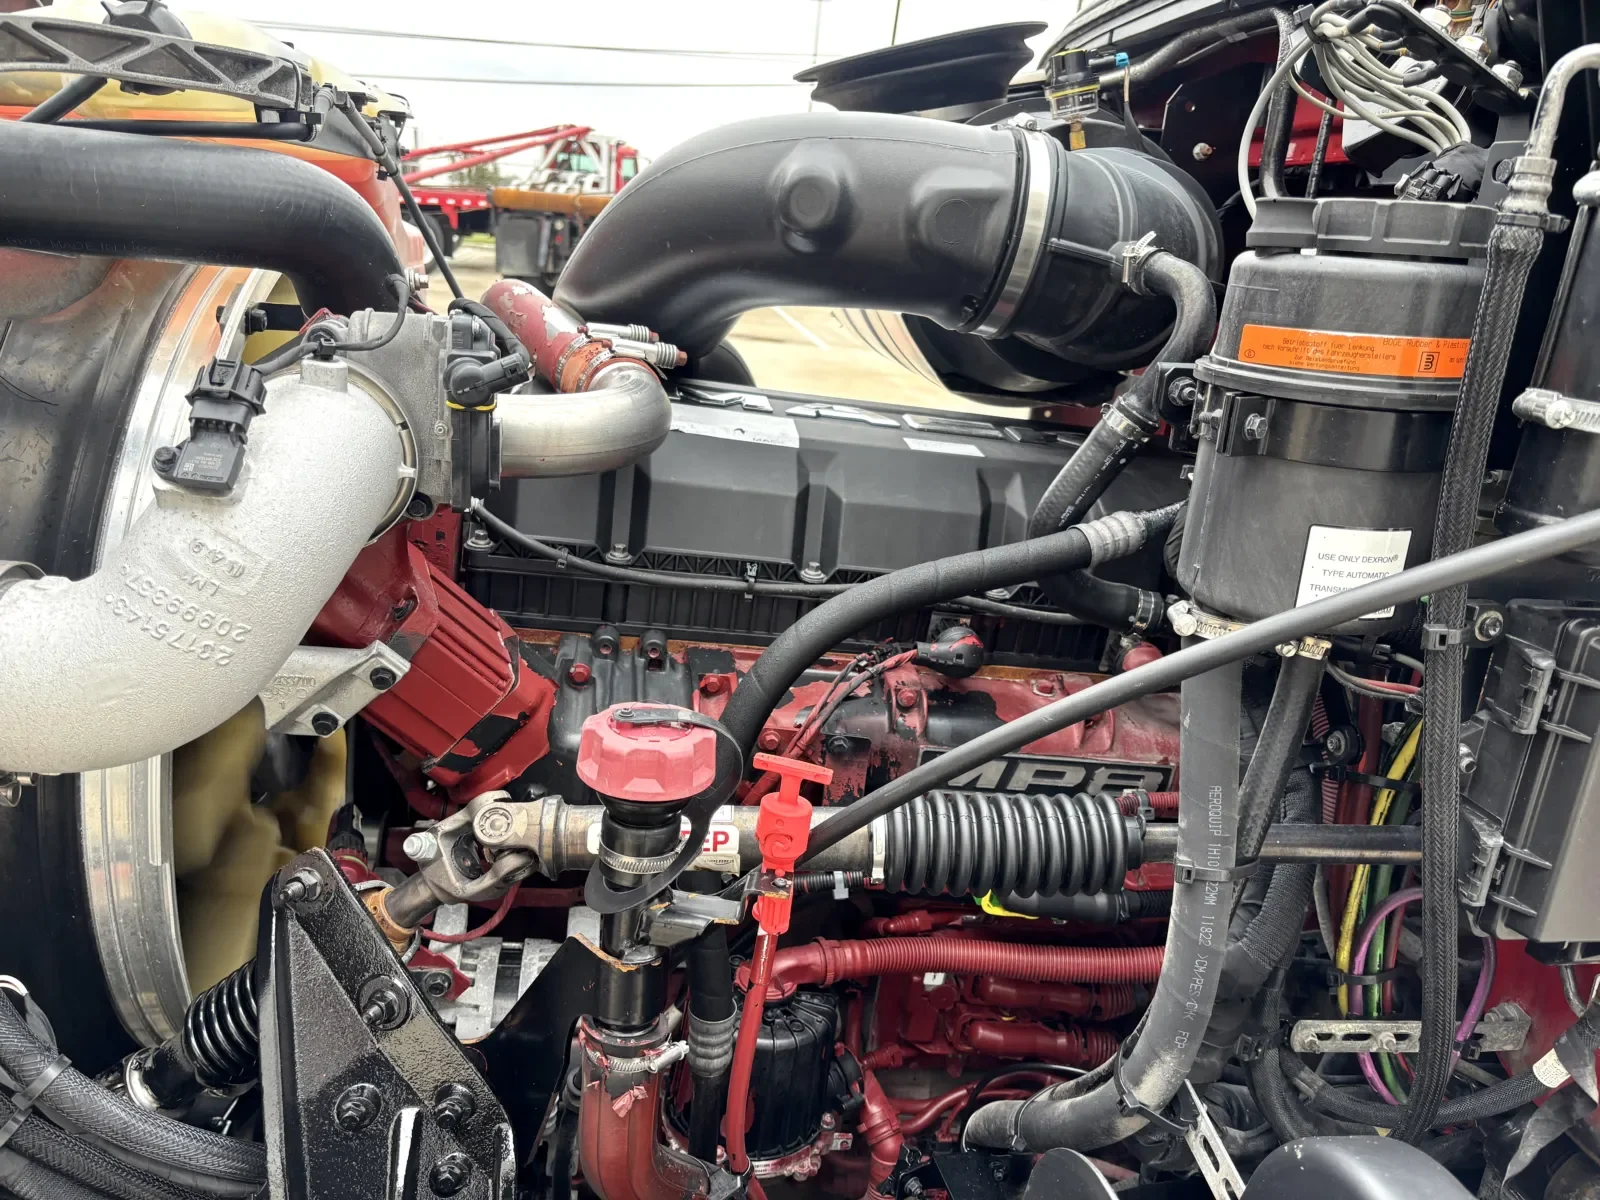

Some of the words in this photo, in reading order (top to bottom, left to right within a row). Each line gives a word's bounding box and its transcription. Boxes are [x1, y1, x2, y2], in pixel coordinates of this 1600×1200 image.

[1348, 343, 1375, 352] Lenkung
[1383, 338, 1402, 347] BOGE
[1407, 339, 1432, 348] Rubber
[1436, 340, 1441, 348] &
[1318, 552, 1336, 561] USE
[1338, 554, 1360, 563] ONLY
[1322, 569, 1344, 578] TYPE
[1346, 571, 1390, 579] AUTOMATIC
[1208, 785, 1222, 837] AEROQUIP
